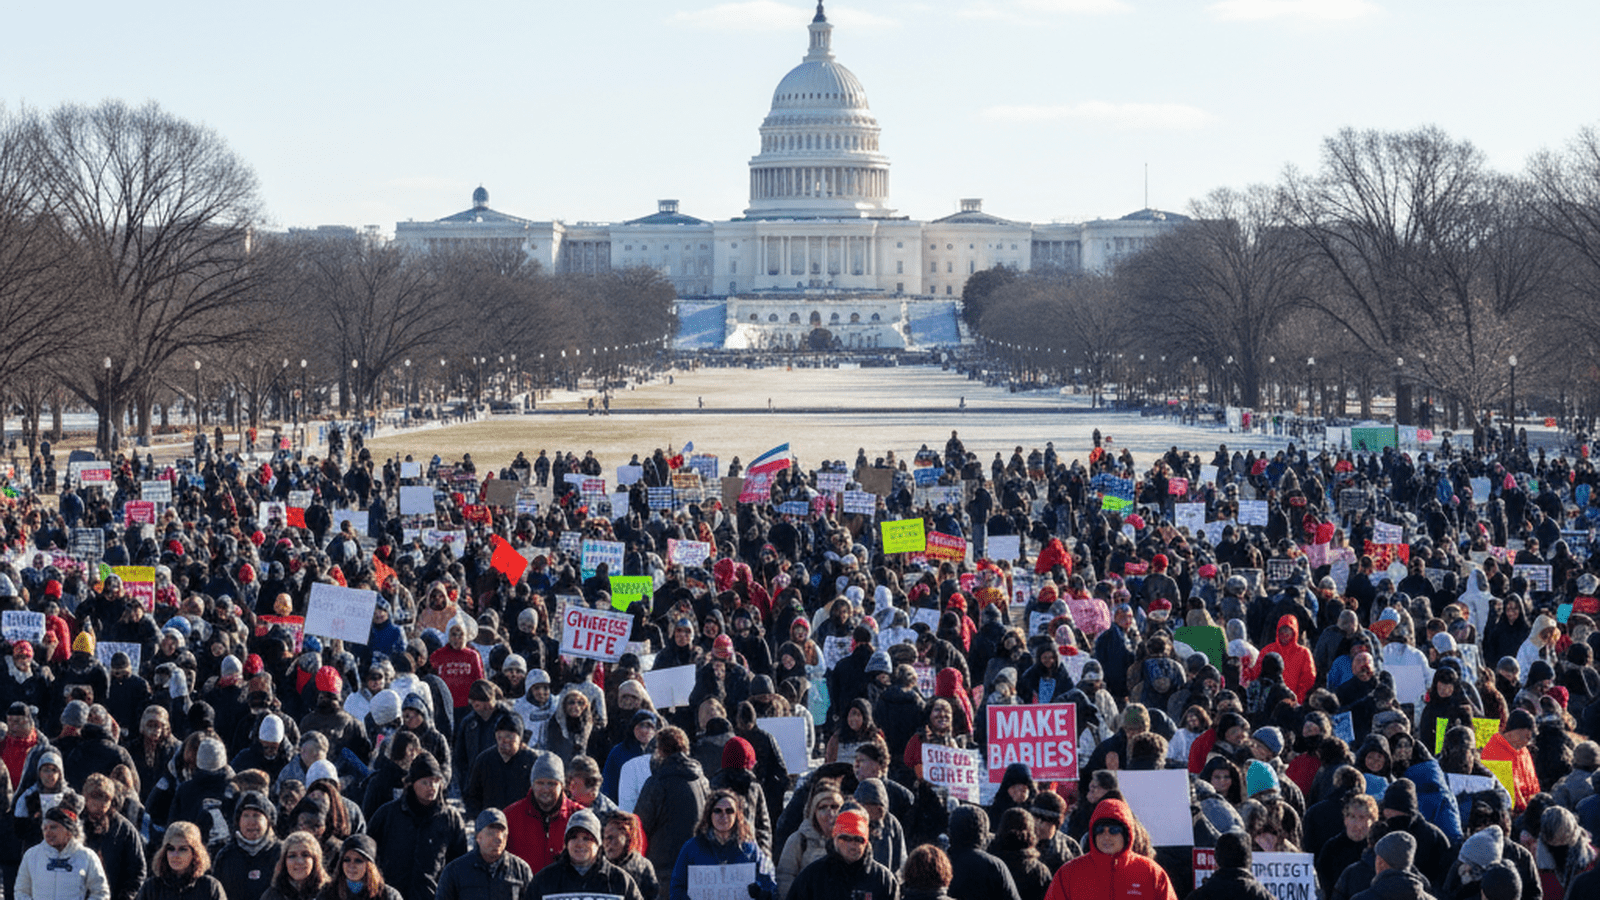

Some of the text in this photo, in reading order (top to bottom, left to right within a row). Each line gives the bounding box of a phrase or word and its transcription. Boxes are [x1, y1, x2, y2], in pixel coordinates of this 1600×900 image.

[573, 630, 617, 655] LIFE
[996, 709, 1068, 739] MAKE
[989, 740, 1074, 769] BABIES
